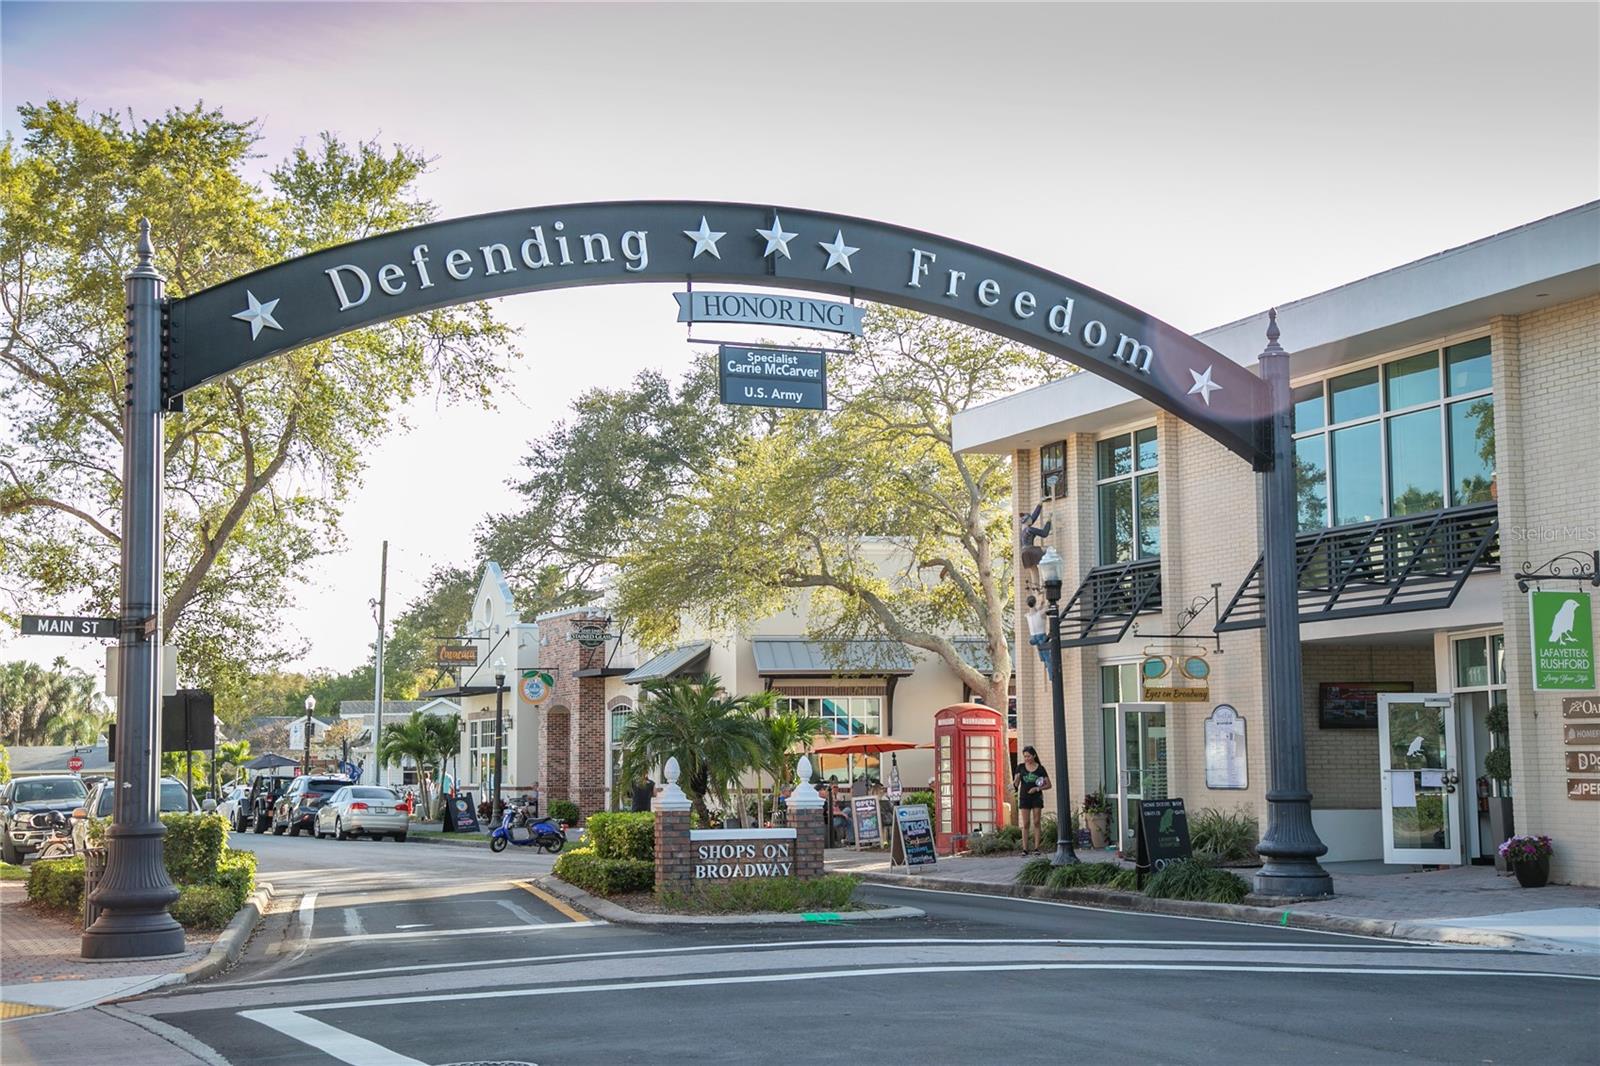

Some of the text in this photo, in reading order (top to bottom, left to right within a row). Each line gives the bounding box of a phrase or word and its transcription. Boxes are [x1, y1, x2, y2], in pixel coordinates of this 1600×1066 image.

[325, 220, 1153, 375] Defending Freedom
[704, 295, 844, 326] HONORING
[747, 352, 798, 365] Specialist
[727, 360, 819, 378] Carrie McCarver
[745, 387, 803, 403] U.S. Army
[38, 620, 99, 634] MAIN ST
[1540, 659, 1590, 669] RUSHFORD
[1145, 689, 1161, 701] Eyes
[1173, 689, 1208, 701] Broadway
[856, 799, 875, 807] OPEN
[698, 843, 789, 859] SHOPS ON
[695, 862, 792, 878] BROADWAY
